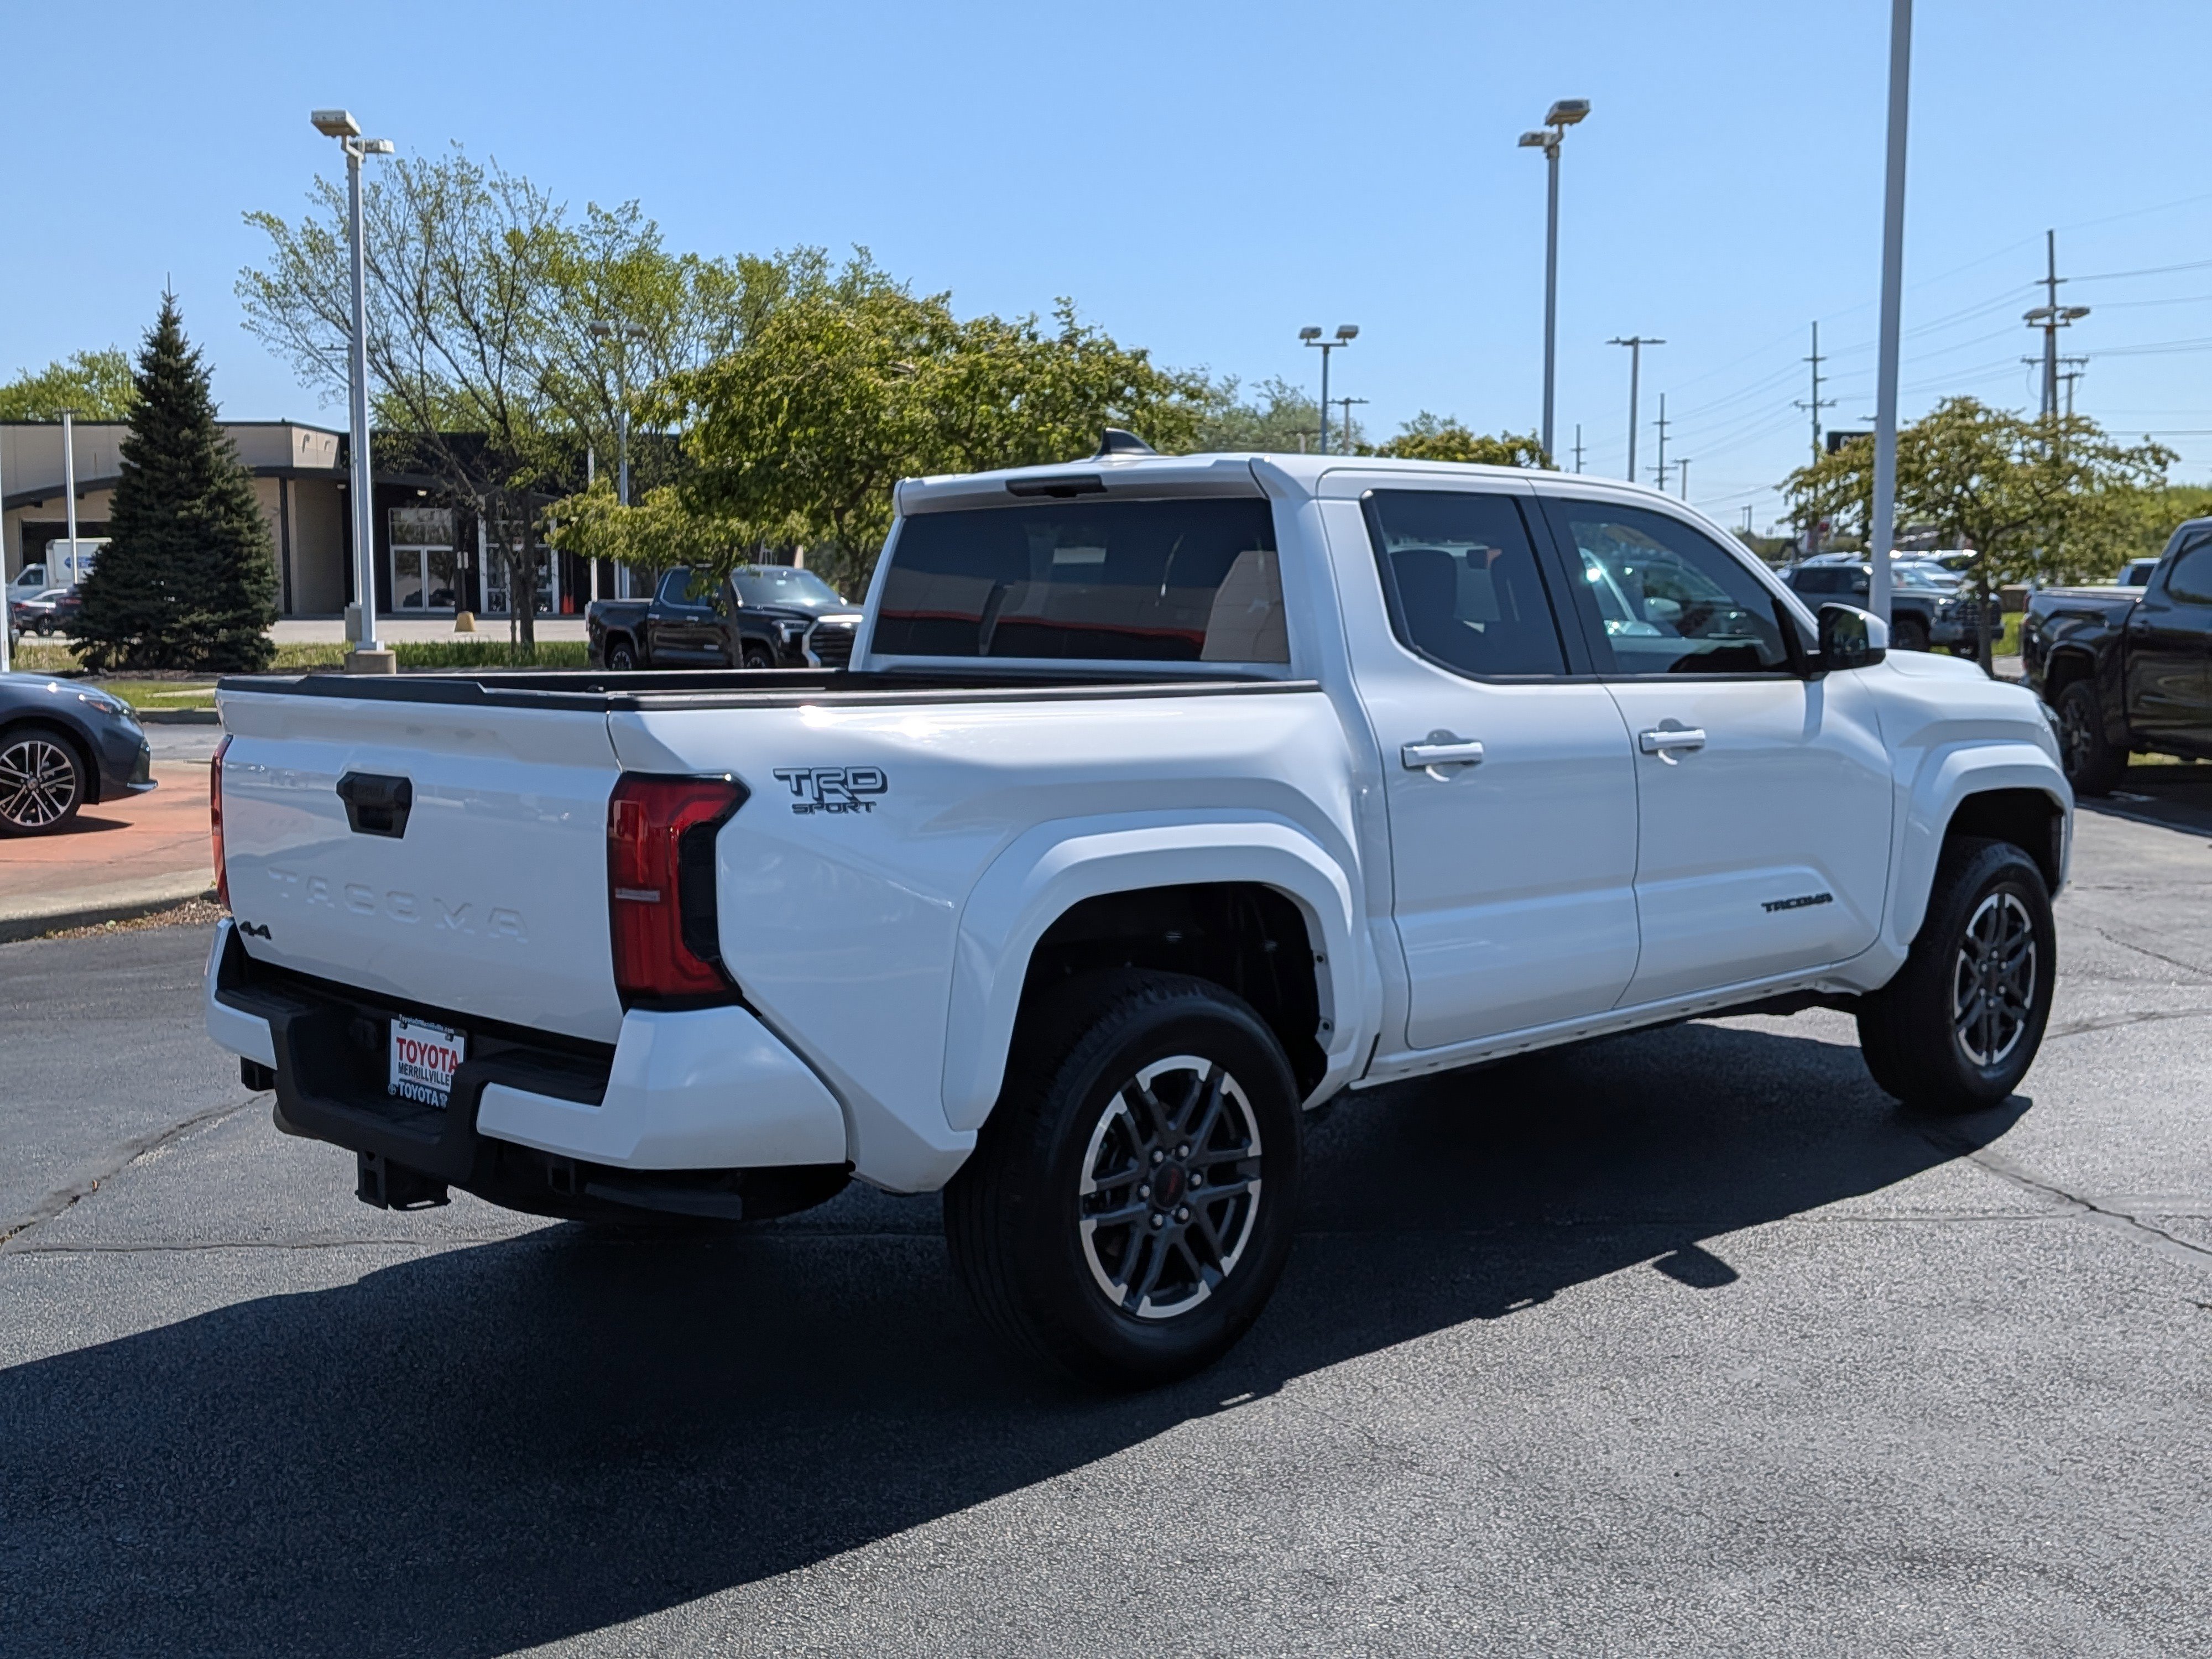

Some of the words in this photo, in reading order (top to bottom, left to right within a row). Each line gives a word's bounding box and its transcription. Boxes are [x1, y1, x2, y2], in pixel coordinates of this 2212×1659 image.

[773, 766, 888, 804] TRD
[792, 801, 877, 815] SPORT
[268, 867, 529, 945] TACOMA
[1761, 891, 1834, 912] TACOMA
[397, 1036, 458, 1073] TOYOTA
[398, 1062, 450, 1087] MERRILLVILLE
[398, 1081, 440, 1107] TOYOTA
